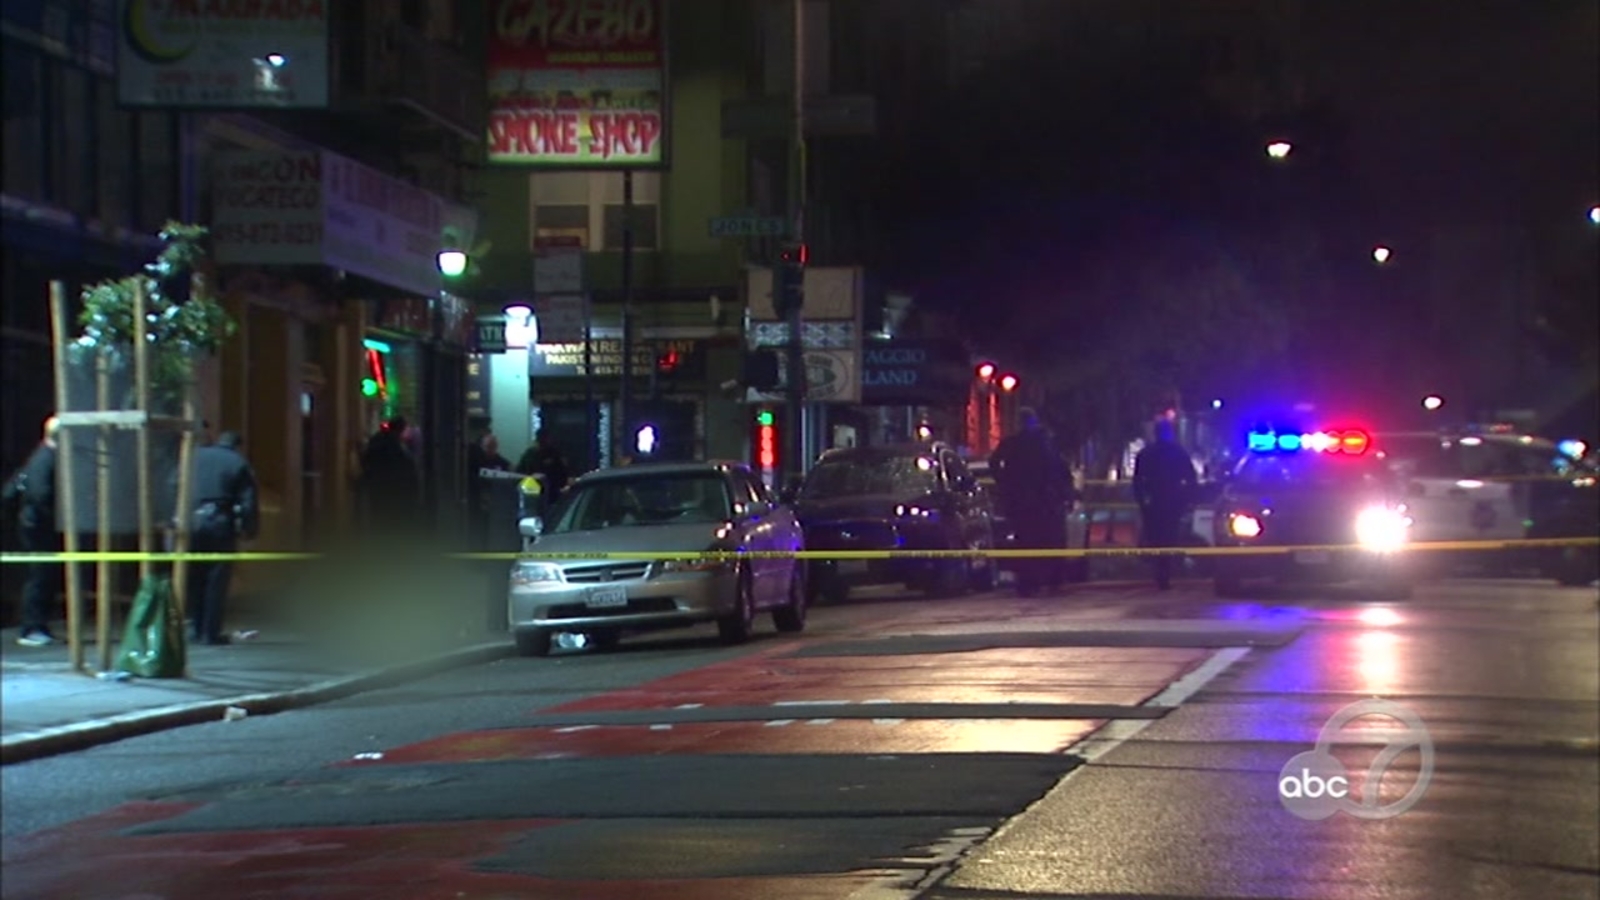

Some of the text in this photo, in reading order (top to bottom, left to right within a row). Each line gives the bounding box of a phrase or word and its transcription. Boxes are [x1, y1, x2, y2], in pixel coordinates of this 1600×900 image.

[489, 110, 661, 159] SMOKE SHOP
[714, 217, 781, 233] JONES
[862, 350, 925, 364] AGGIO
